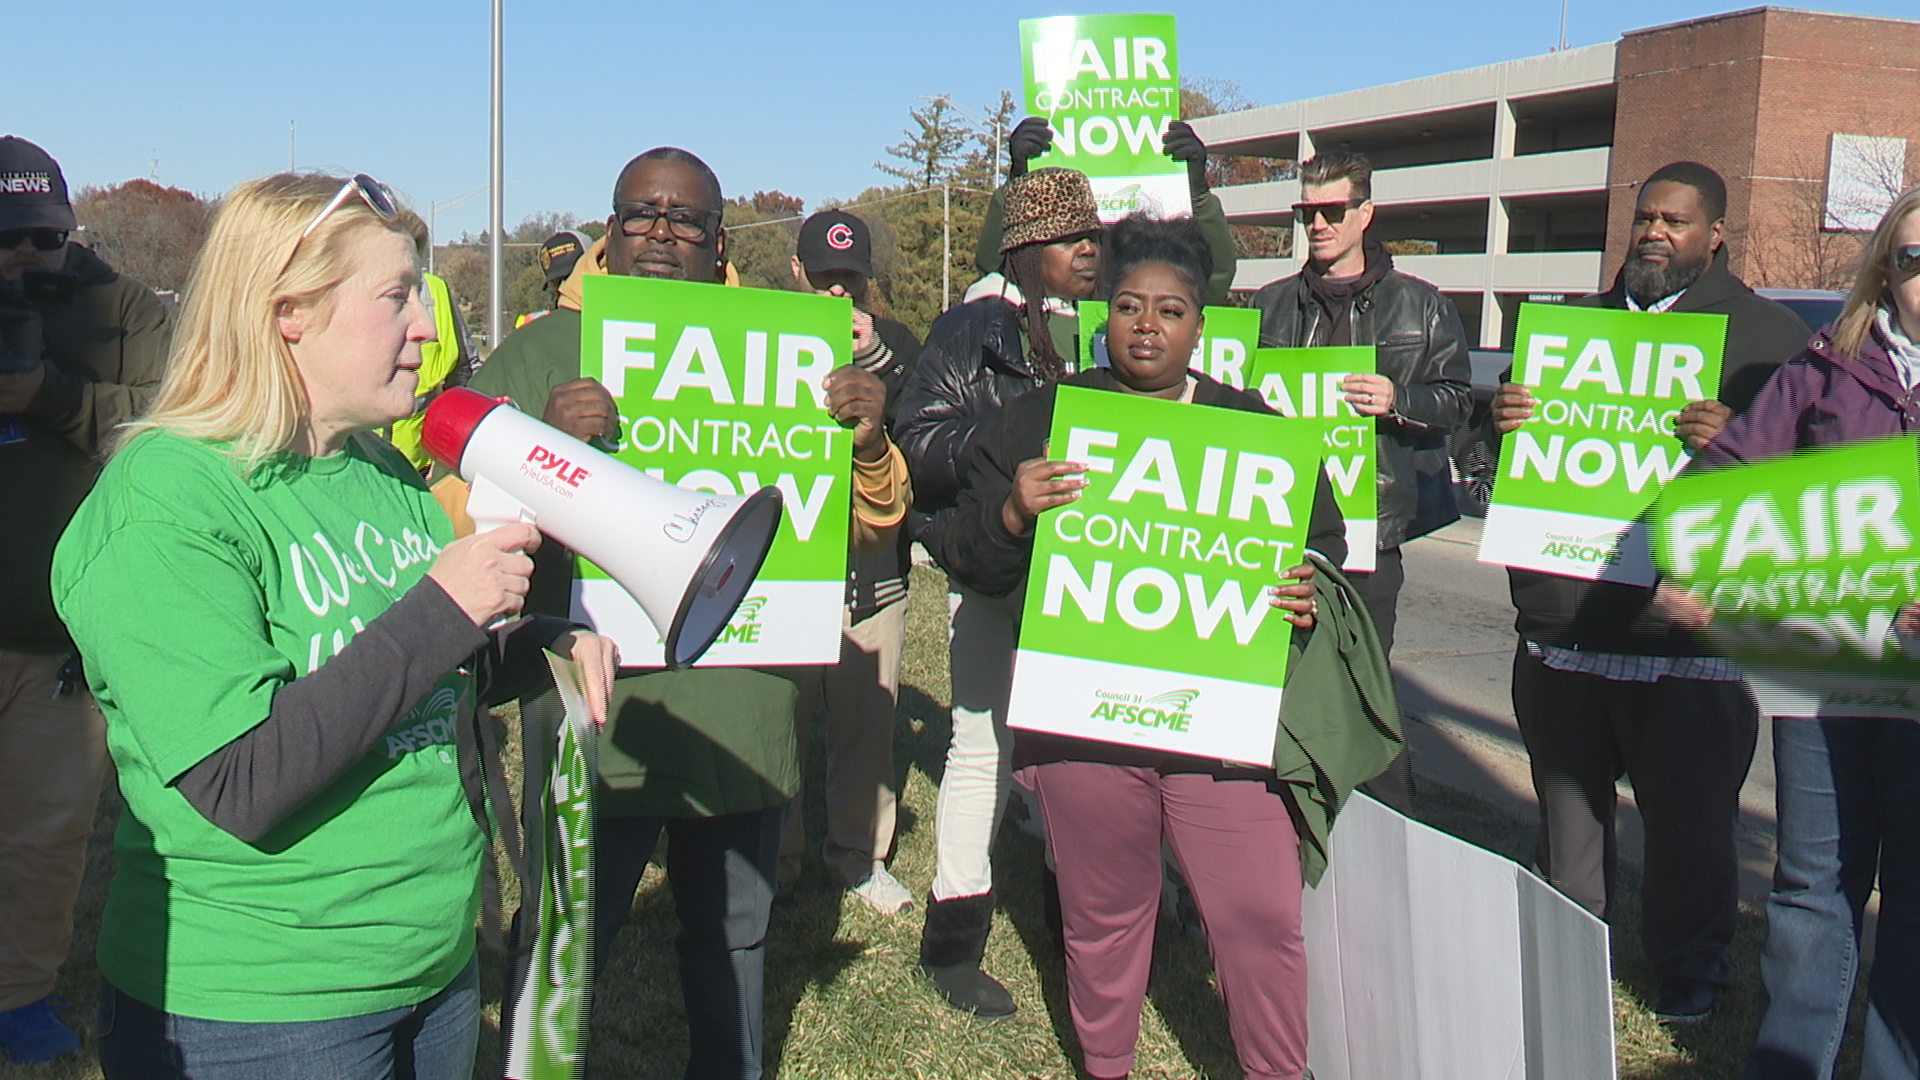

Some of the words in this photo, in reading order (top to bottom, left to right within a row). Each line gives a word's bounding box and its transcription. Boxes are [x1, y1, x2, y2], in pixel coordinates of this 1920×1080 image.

[1035, 86, 1174, 110] CONTRACT
[1041, 113, 1173, 157] NOW
[0, 179, 51, 193] NEWS
[826, 223, 854, 250] C
[602, 319, 835, 410] FAIR
[1523, 333, 1705, 401] FAIR
[1259, 371, 1362, 418] AIR
[1526, 398, 1678, 437] ONTRAC
[526, 444, 589, 488] PYLE
[1063, 426, 1296, 528] FAIR
[1509, 431, 1692, 493] NOW
[1054, 509, 1294, 573] CONTRACT
[1664, 475, 1914, 579] FAIR
[289, 531, 366, 616] We
[1042, 553, 1277, 646] NOW
[1090, 701, 1193, 732] AFSCME
[1095, 689, 1131, 702] Council
[385, 715, 457, 758] AFSCM
